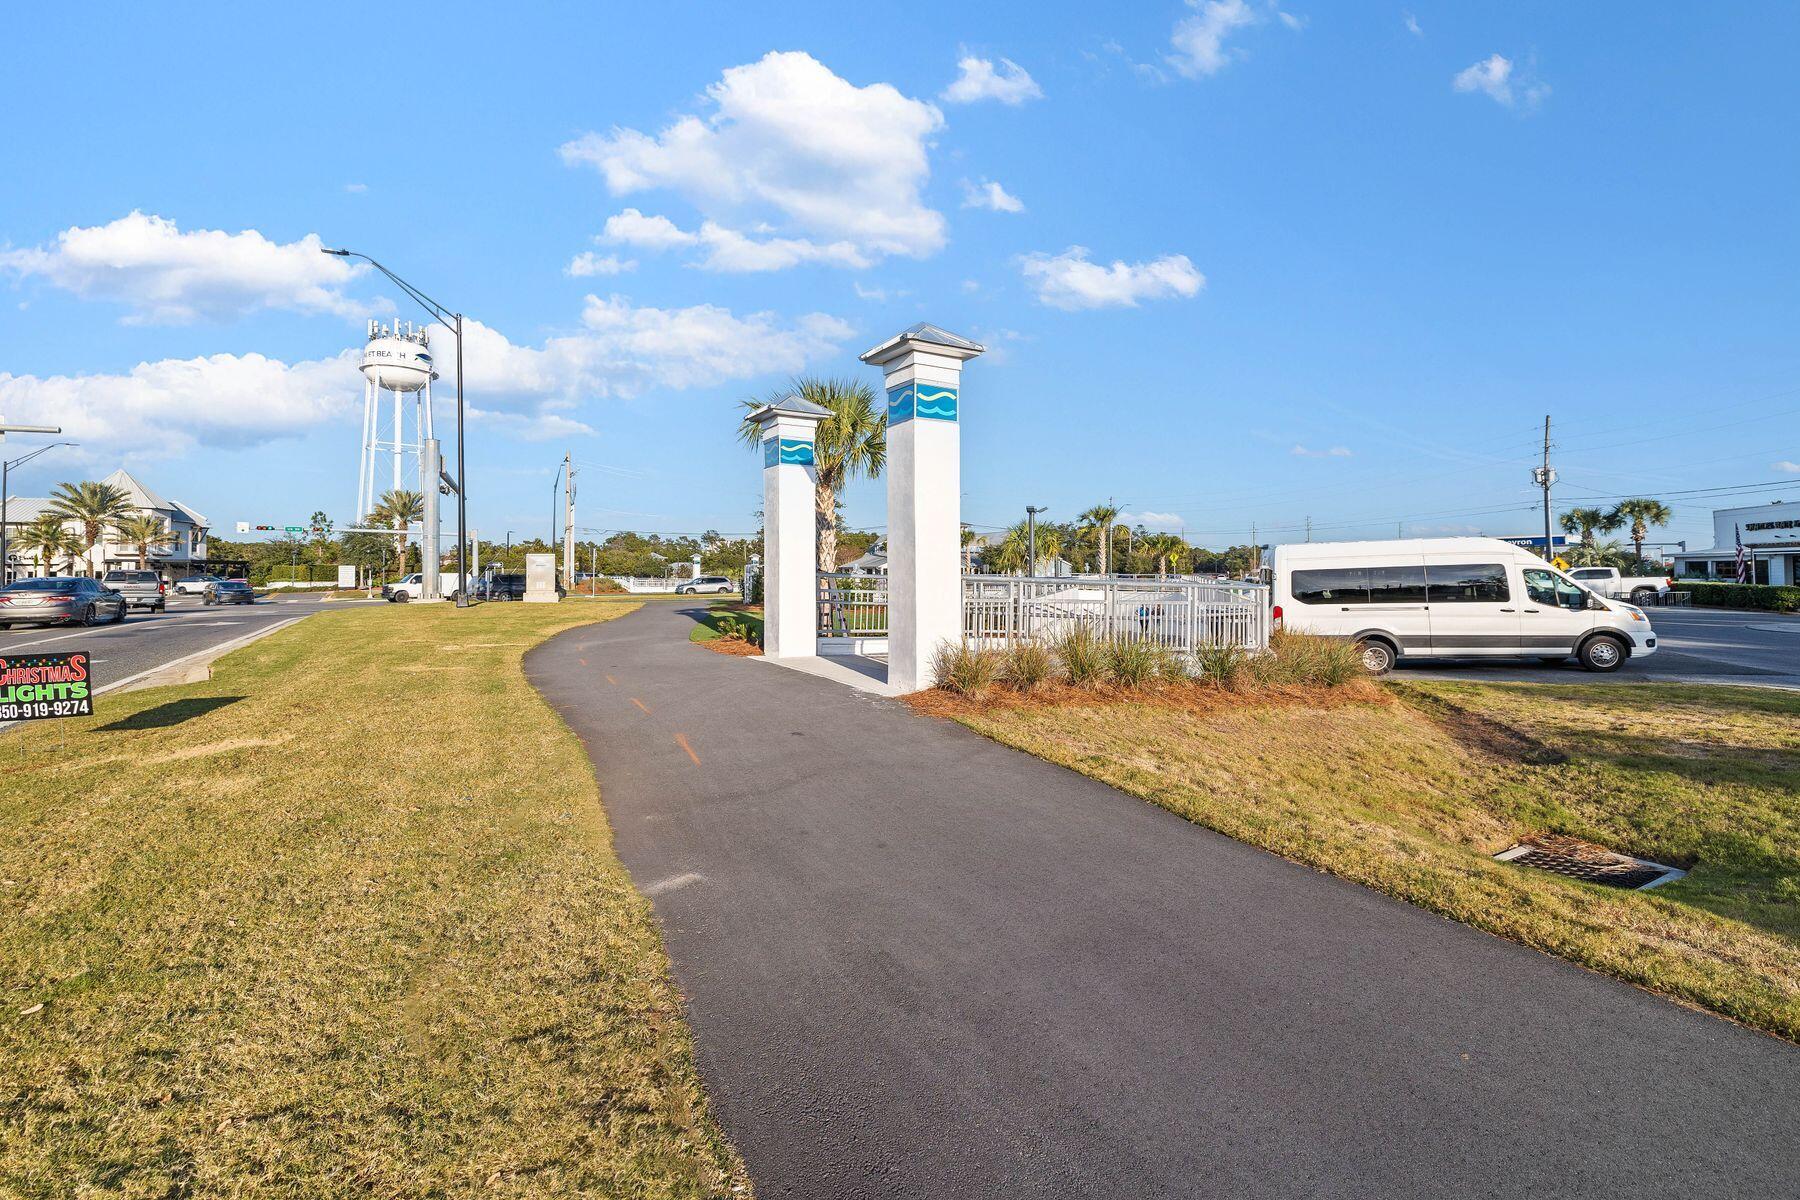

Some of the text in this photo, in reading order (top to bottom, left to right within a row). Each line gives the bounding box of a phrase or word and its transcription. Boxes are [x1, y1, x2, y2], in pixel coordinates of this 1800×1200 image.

[376, 350, 406, 359] BEAH
[0, 681, 89, 703] LIGHTS
[0, 700, 90, 719] 50-919-9274
